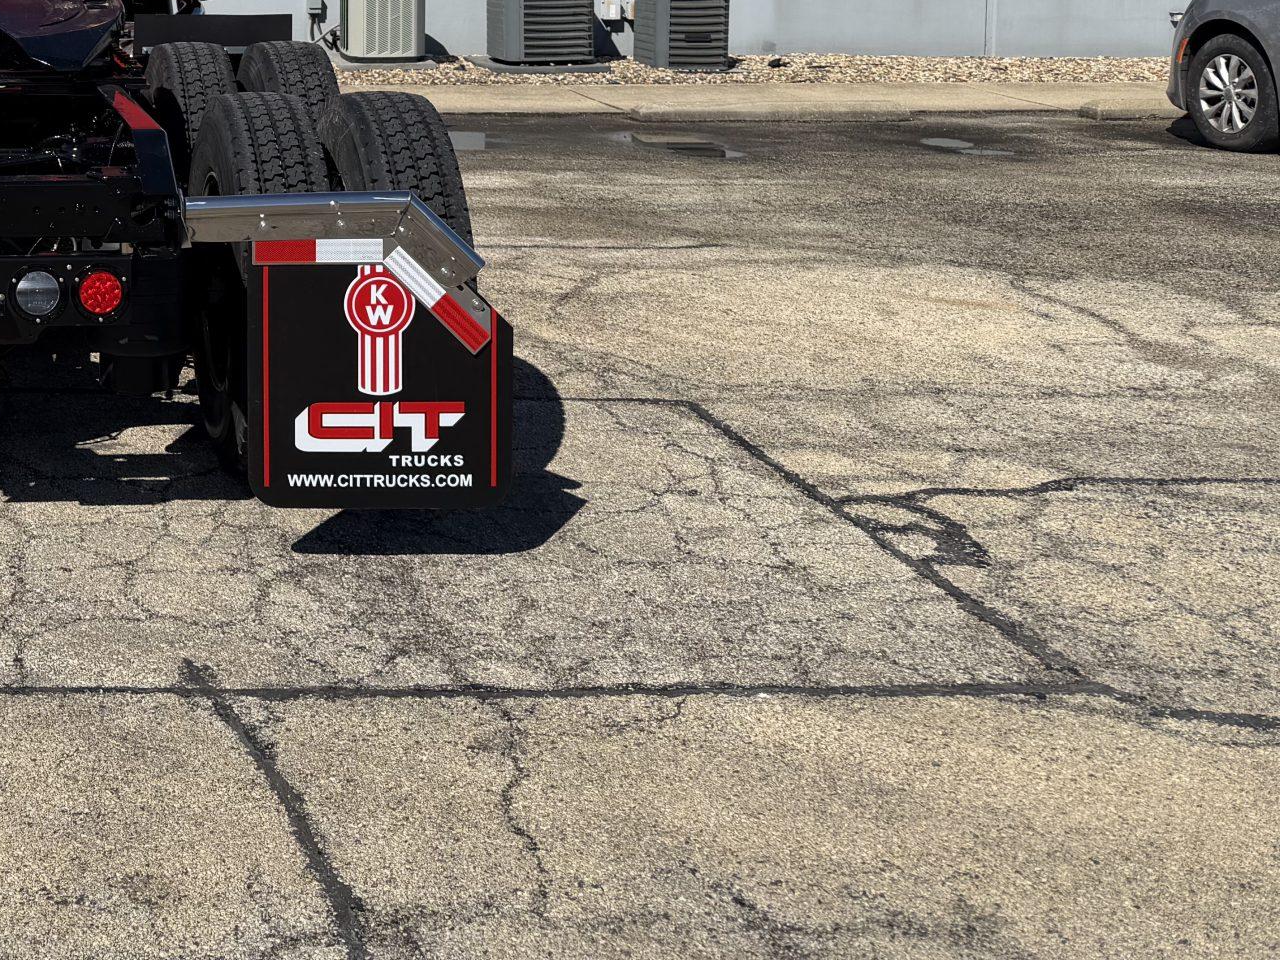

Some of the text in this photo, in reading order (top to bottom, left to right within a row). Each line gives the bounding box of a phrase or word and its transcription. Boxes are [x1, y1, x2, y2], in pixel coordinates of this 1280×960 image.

[370, 284, 388, 304] K
[365, 305, 393, 326] W
[300, 401, 466, 446] CIT
[388, 454, 465, 467] TRUCKS
[287, 473, 473, 488] WWW.CITTRUCKS.COM
